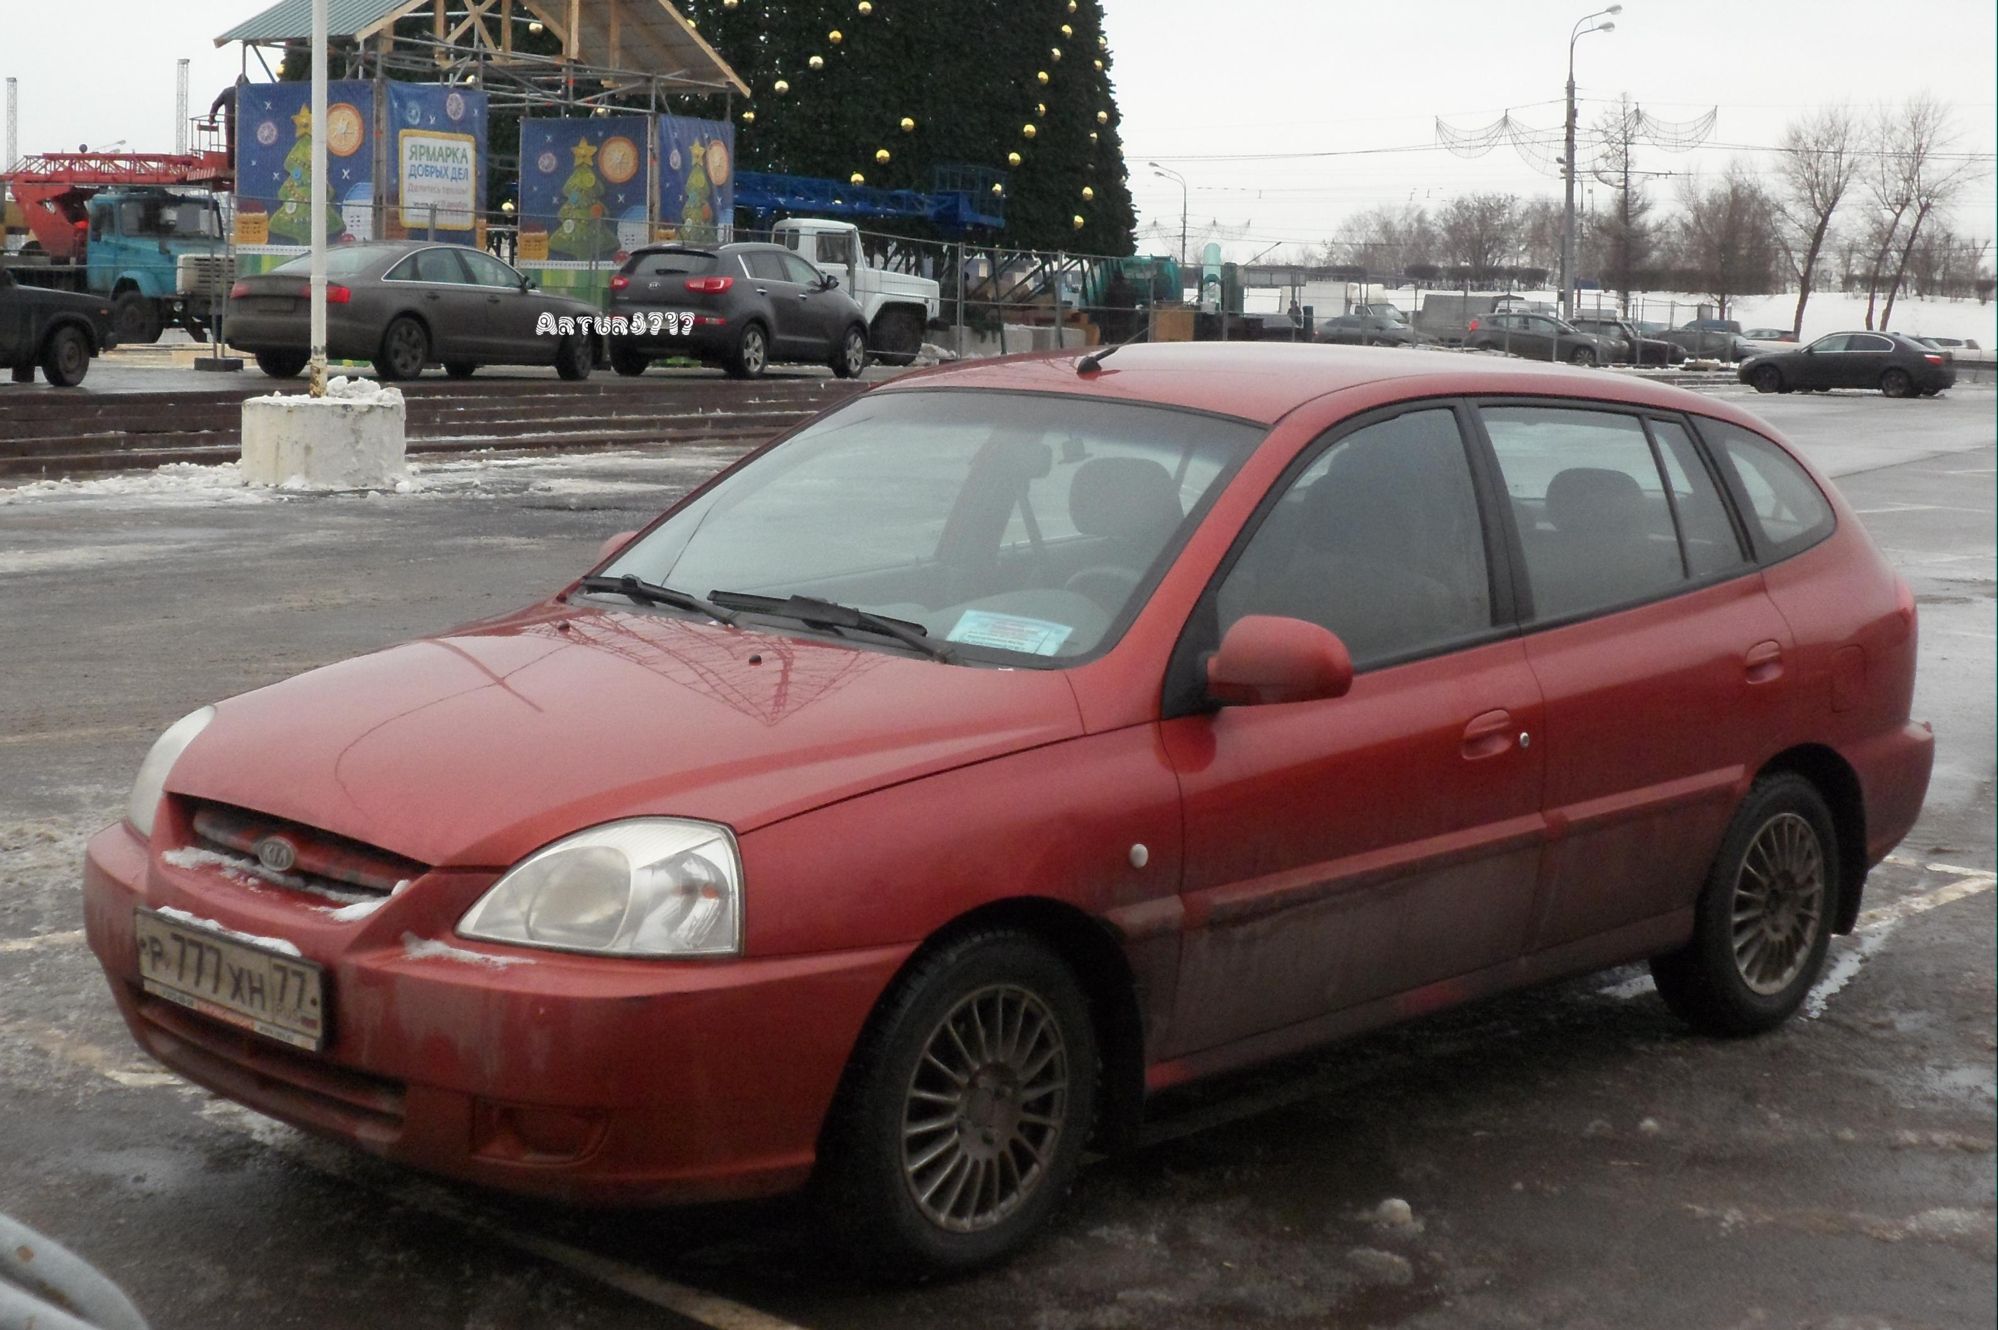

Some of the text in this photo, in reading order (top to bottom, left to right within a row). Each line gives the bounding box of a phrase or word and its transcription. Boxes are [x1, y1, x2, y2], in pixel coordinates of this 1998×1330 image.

[408, 144, 469, 164] ЯРМАРКА
[408, 164, 469, 182] ДОБРЫХ ДЕЛ
